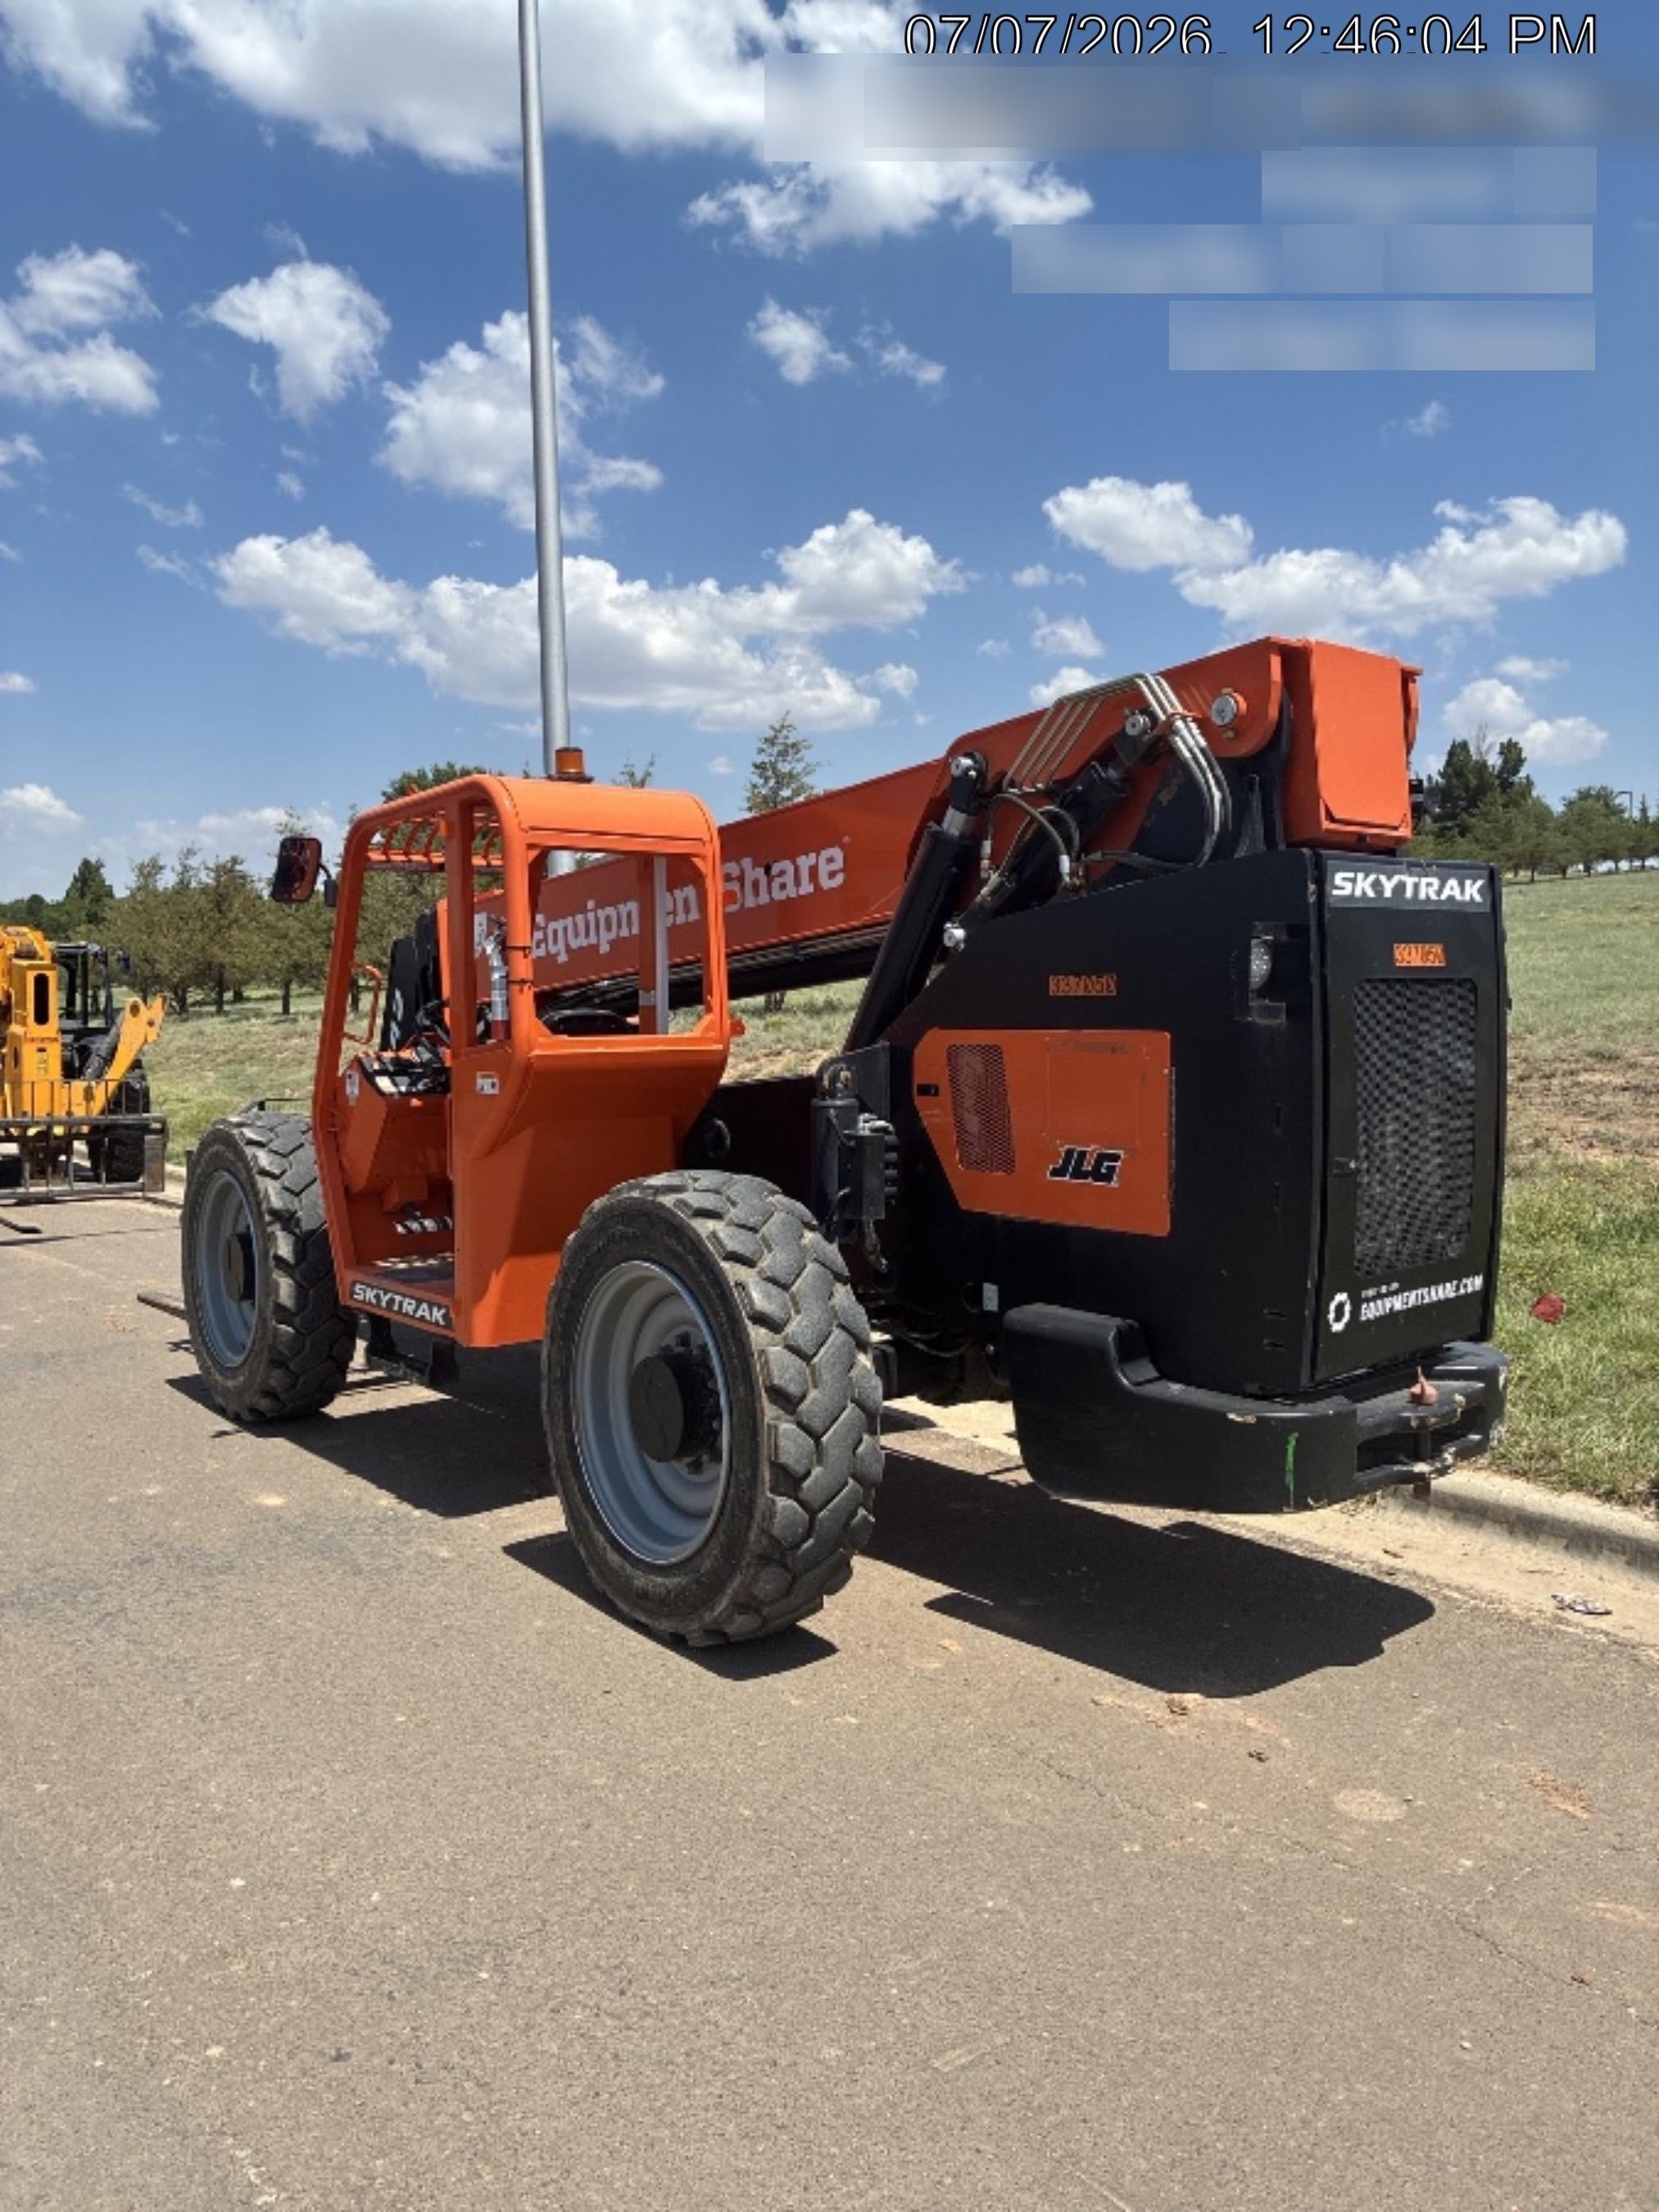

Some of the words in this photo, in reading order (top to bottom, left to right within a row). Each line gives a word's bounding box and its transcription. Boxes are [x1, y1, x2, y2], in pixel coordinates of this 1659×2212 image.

[1331, 872, 1485, 902] SKYTRAK
[1048, 1145, 1124, 1187] JLG
[353, 1283, 446, 1326] SKYTRAK
